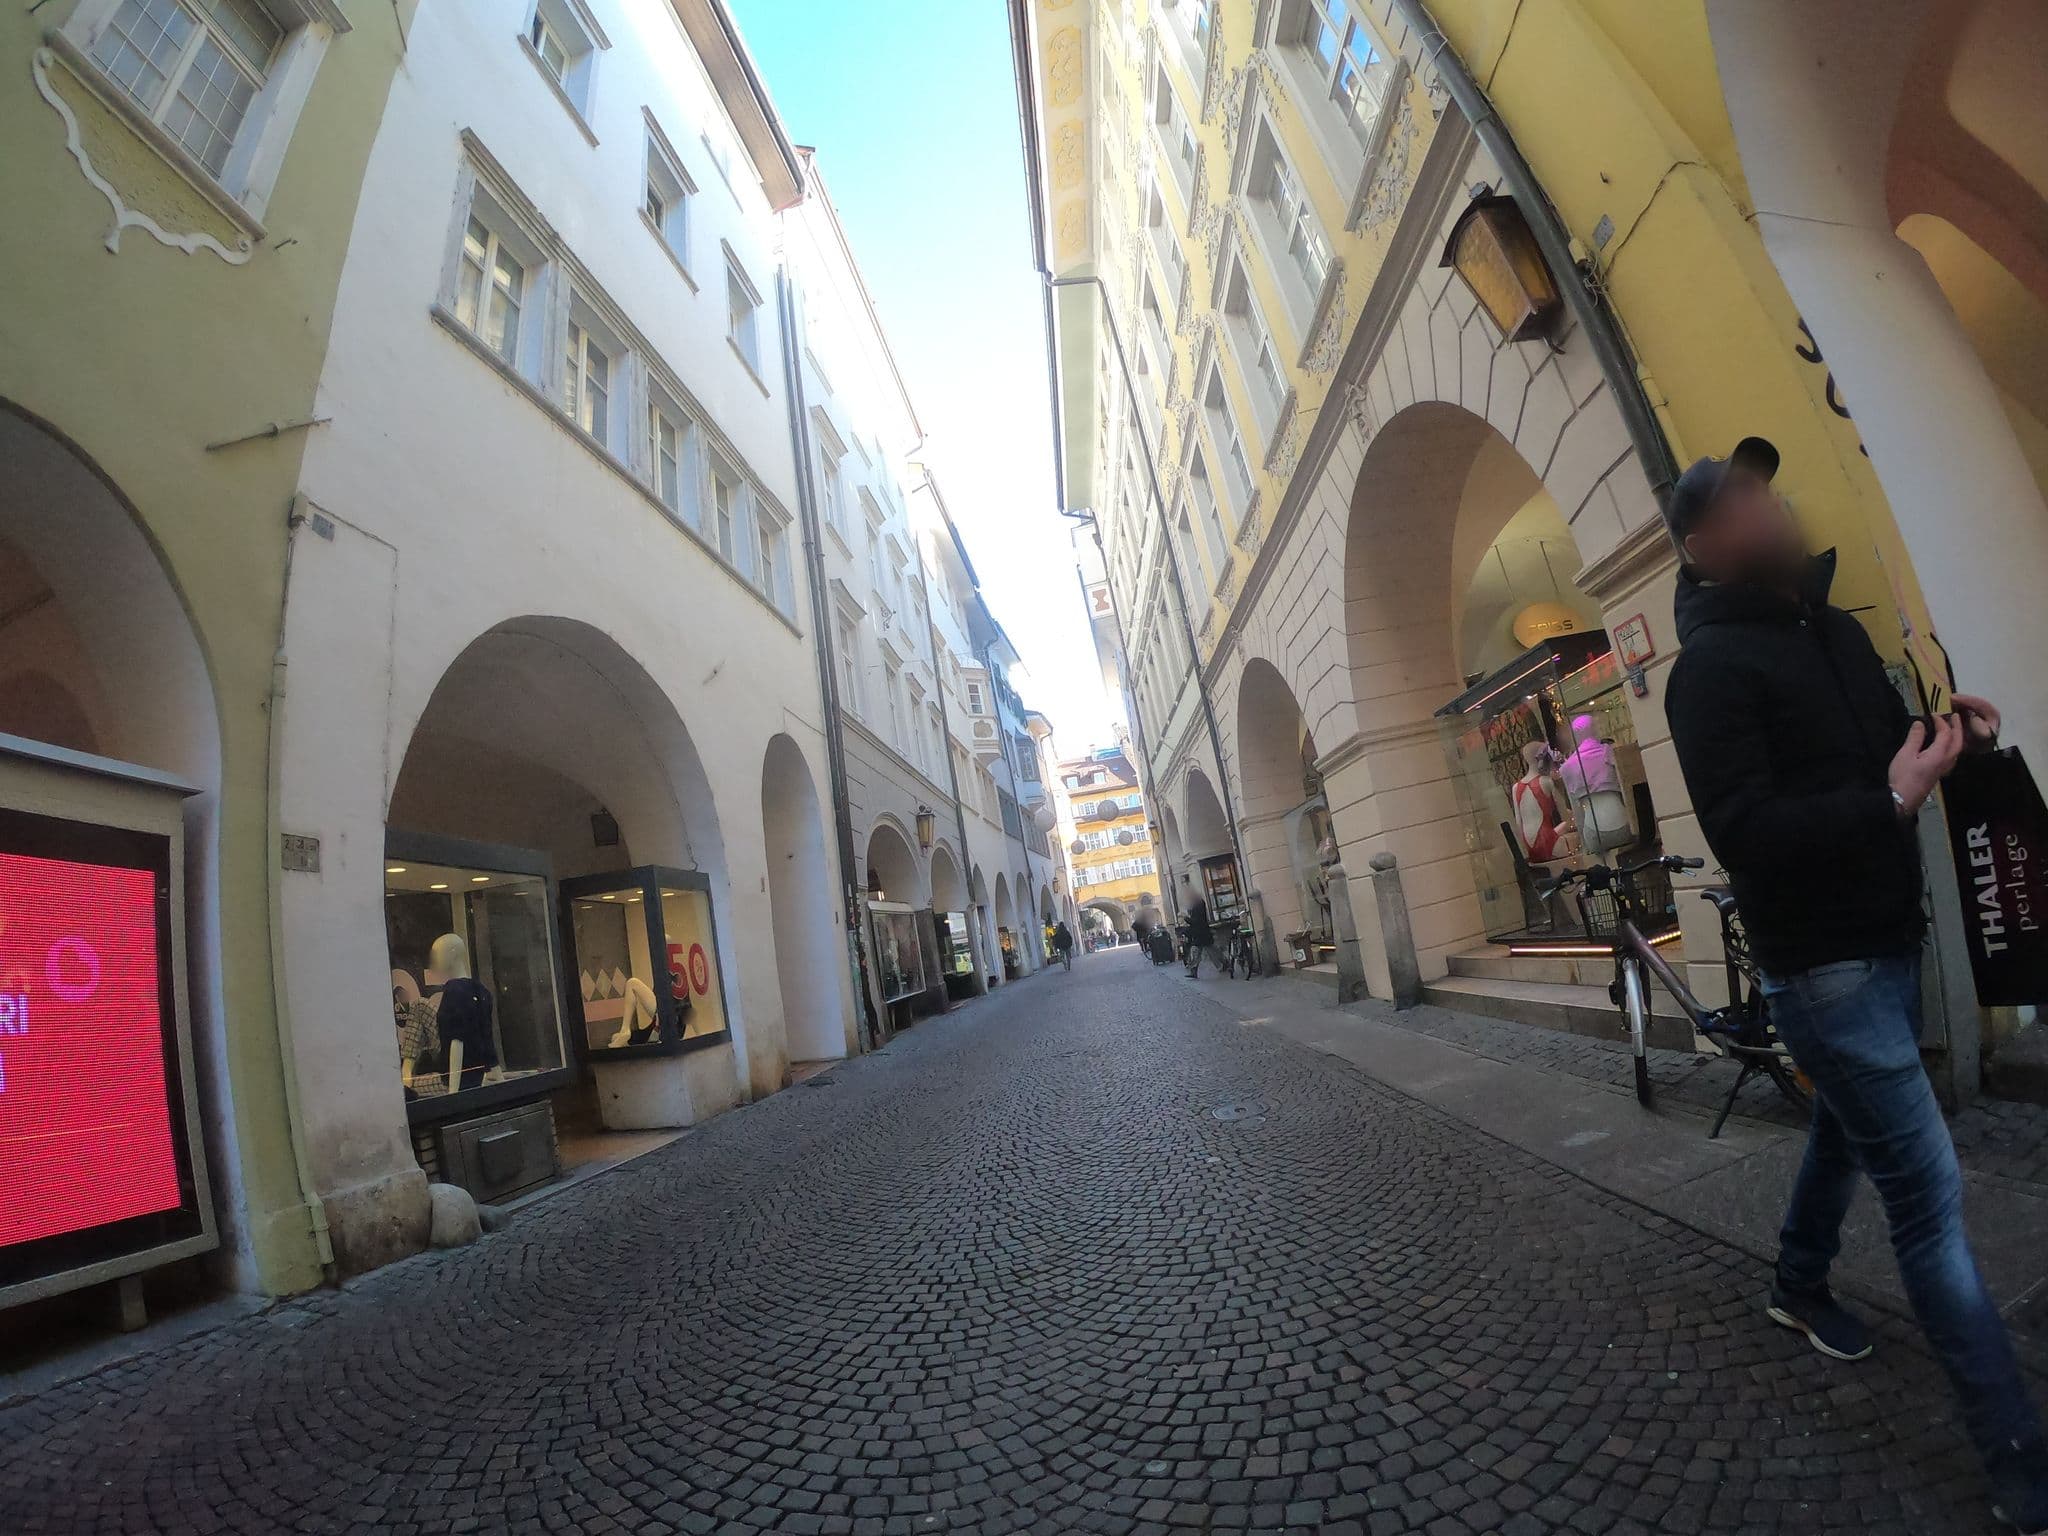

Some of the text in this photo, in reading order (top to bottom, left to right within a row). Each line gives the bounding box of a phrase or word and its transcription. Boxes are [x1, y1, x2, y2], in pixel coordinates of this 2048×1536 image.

[1966, 822, 2008, 958] THALER
[2005, 833, 2040, 932] perlage
[665, 942, 710, 1000] 50
